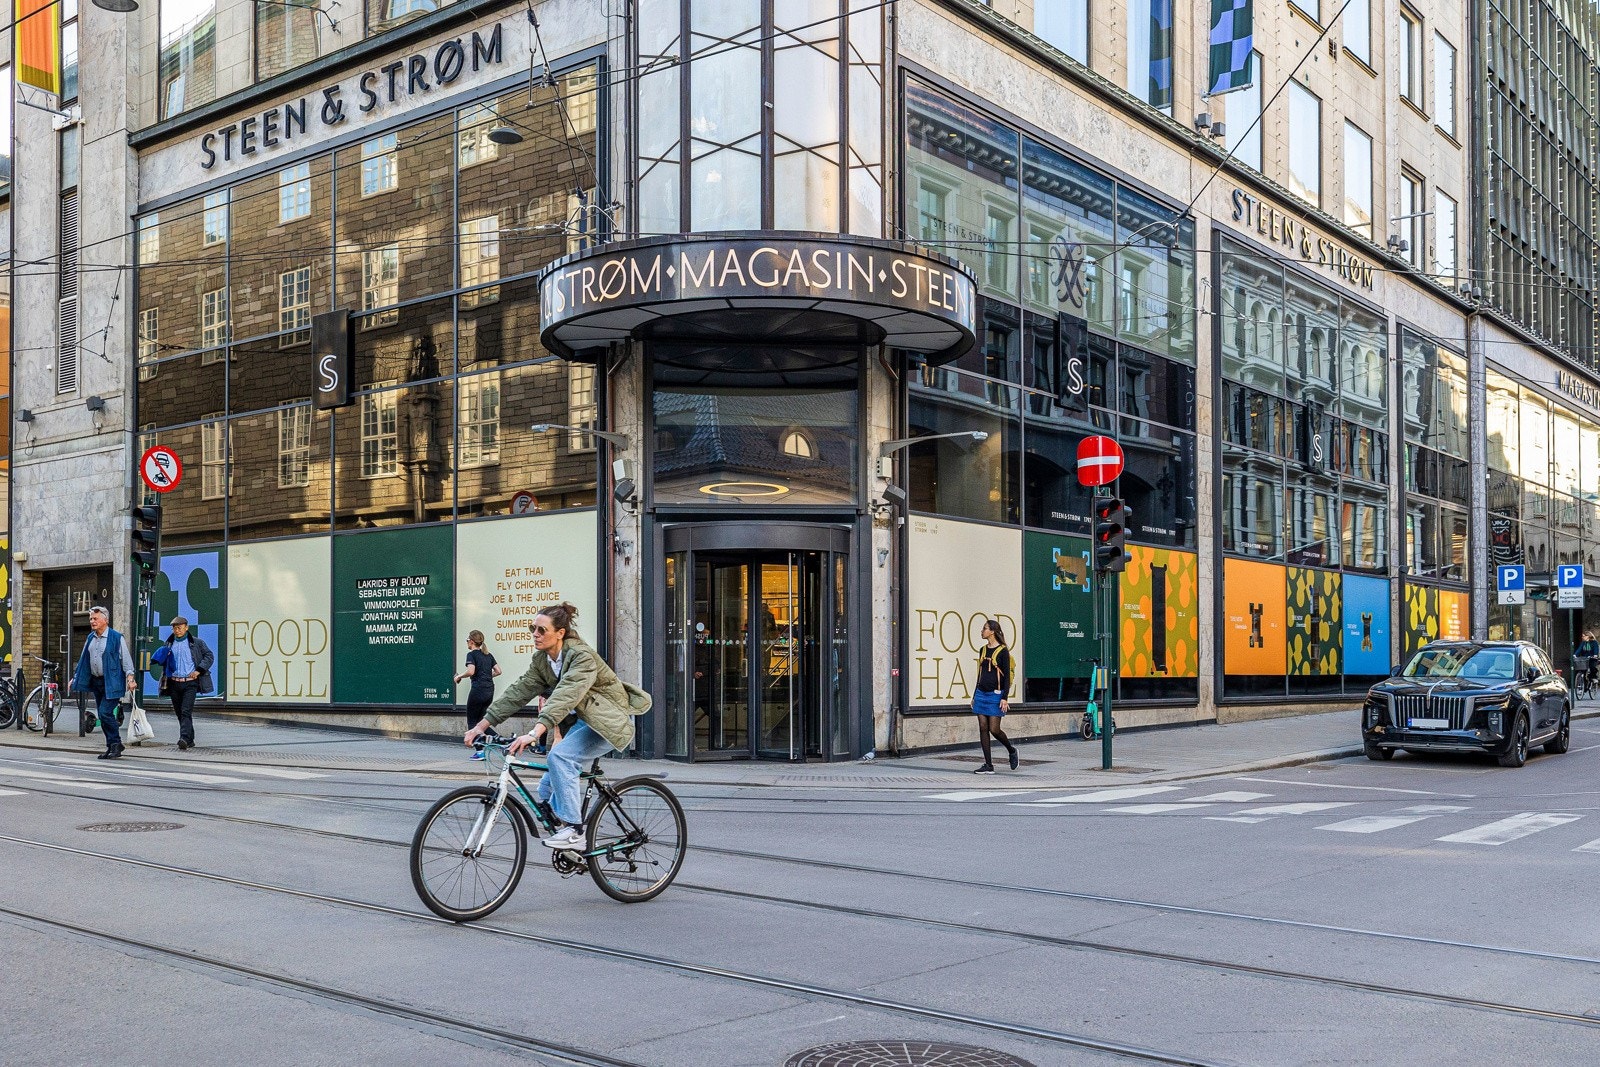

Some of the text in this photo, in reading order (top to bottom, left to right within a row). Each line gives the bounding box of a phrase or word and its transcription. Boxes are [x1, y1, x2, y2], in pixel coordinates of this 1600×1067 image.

[201, 22, 503, 169] STEEN & STRØM
[1232, 188, 1374, 292] STEEN & STRØM
[555, 254, 661, 313] STRØM
[681, 247, 874, 293] MAGASIN
[891, 259, 967, 317] STEEN
[318, 354, 339, 393] S
[1067, 357, 1084, 395] S
[1312, 433, 1323, 462] S
[505, 567, 544, 578] EAT THAI
[1504, 569, 1518, 588] P
[1564, 568, 1577, 585] P
[357, 576, 428, 589] LAKRIDS BY BÜLOW
[497, 579, 552, 591] FLY CHICKEN
[358, 587, 426, 599] SEBASTIEN BRUNO
[489, 592, 560, 604] JOE & THE JUICE
[363, 599, 420, 610] VINMONOPOLET
[360, 610, 423, 622] JONATHAN SUSHI
[365, 623, 418, 633] MAMMA PIZZA
[915, 609, 1017, 653] FOOD
[230, 618, 328, 657] FOOD
[368, 635, 414, 645] MATKROKEN
[494, 632, 532, 642] OLIVIERS
[514, 645, 535, 654] LETT
[230, 660, 328, 698] HALL
